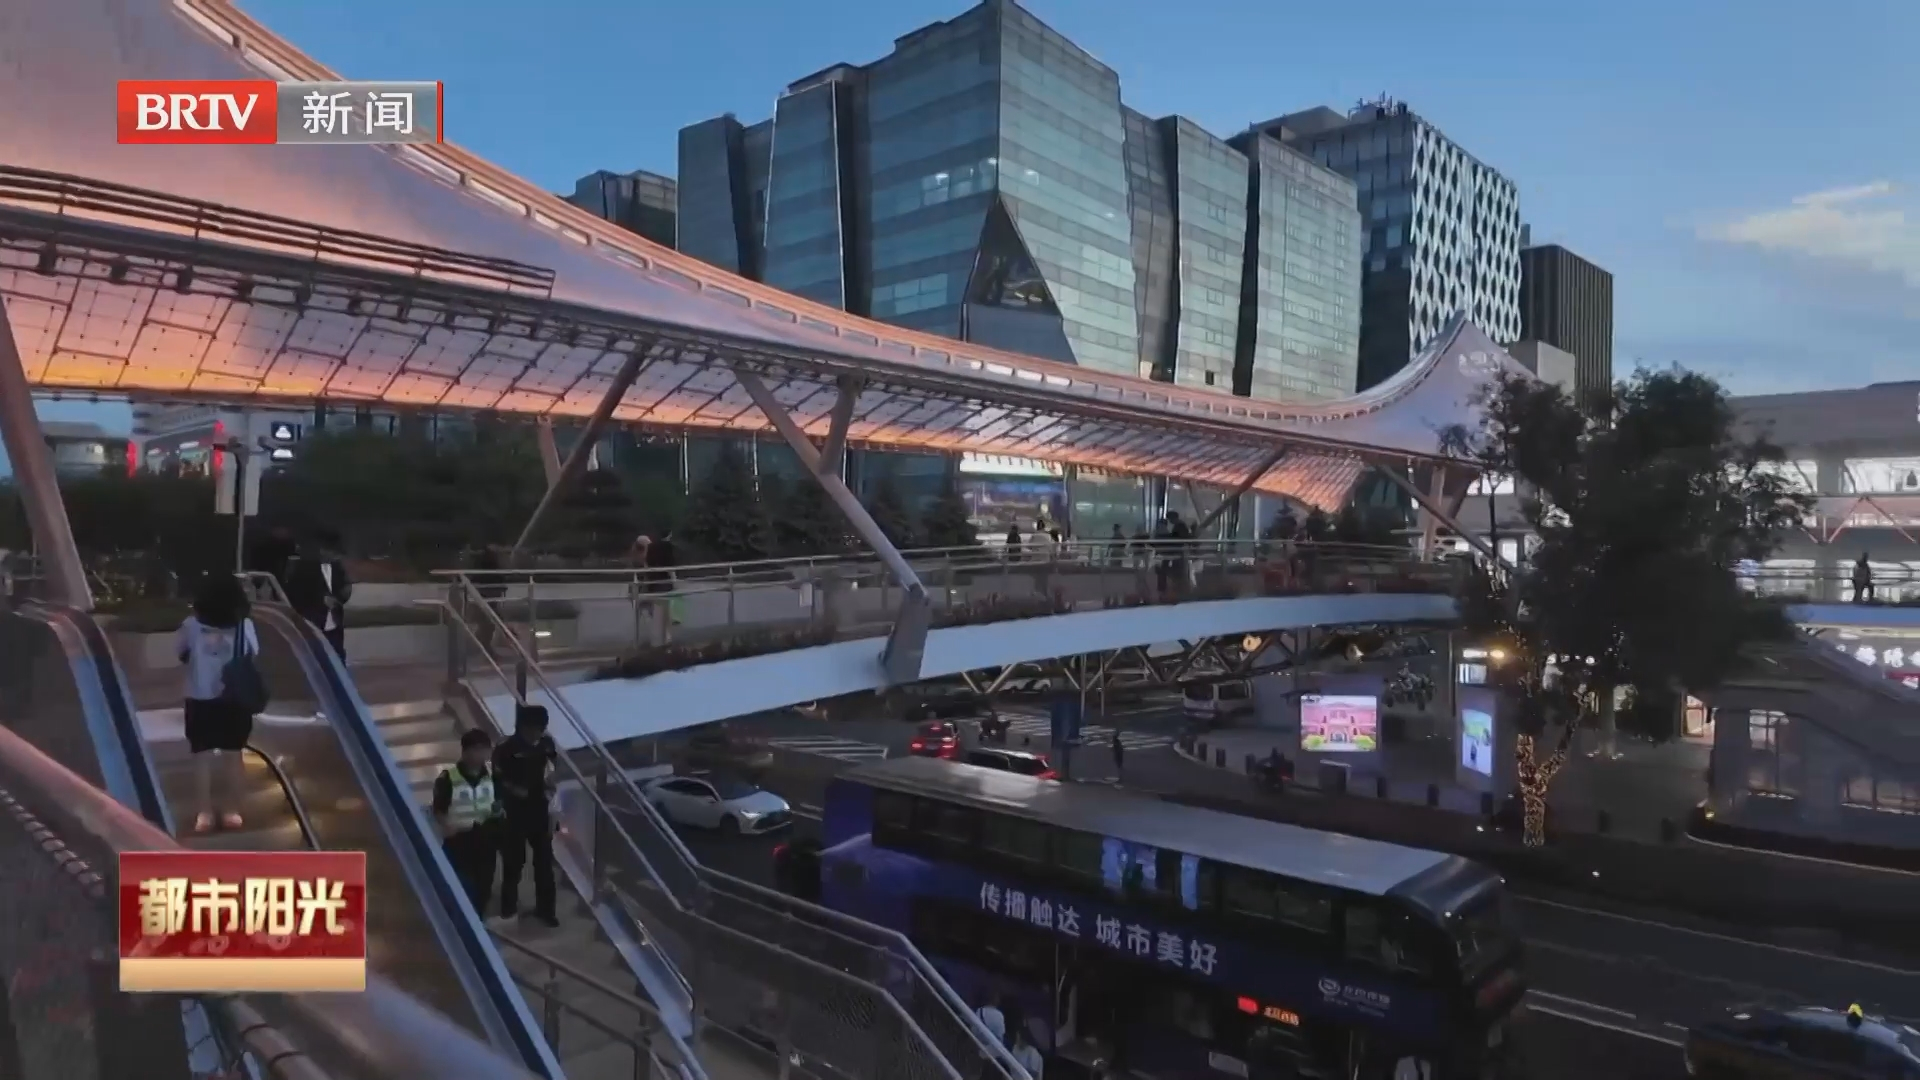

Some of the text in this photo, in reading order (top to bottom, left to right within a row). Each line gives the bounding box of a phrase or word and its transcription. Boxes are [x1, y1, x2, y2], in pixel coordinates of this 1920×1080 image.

[979, 881, 1218, 976] 传播触达 城市美好
